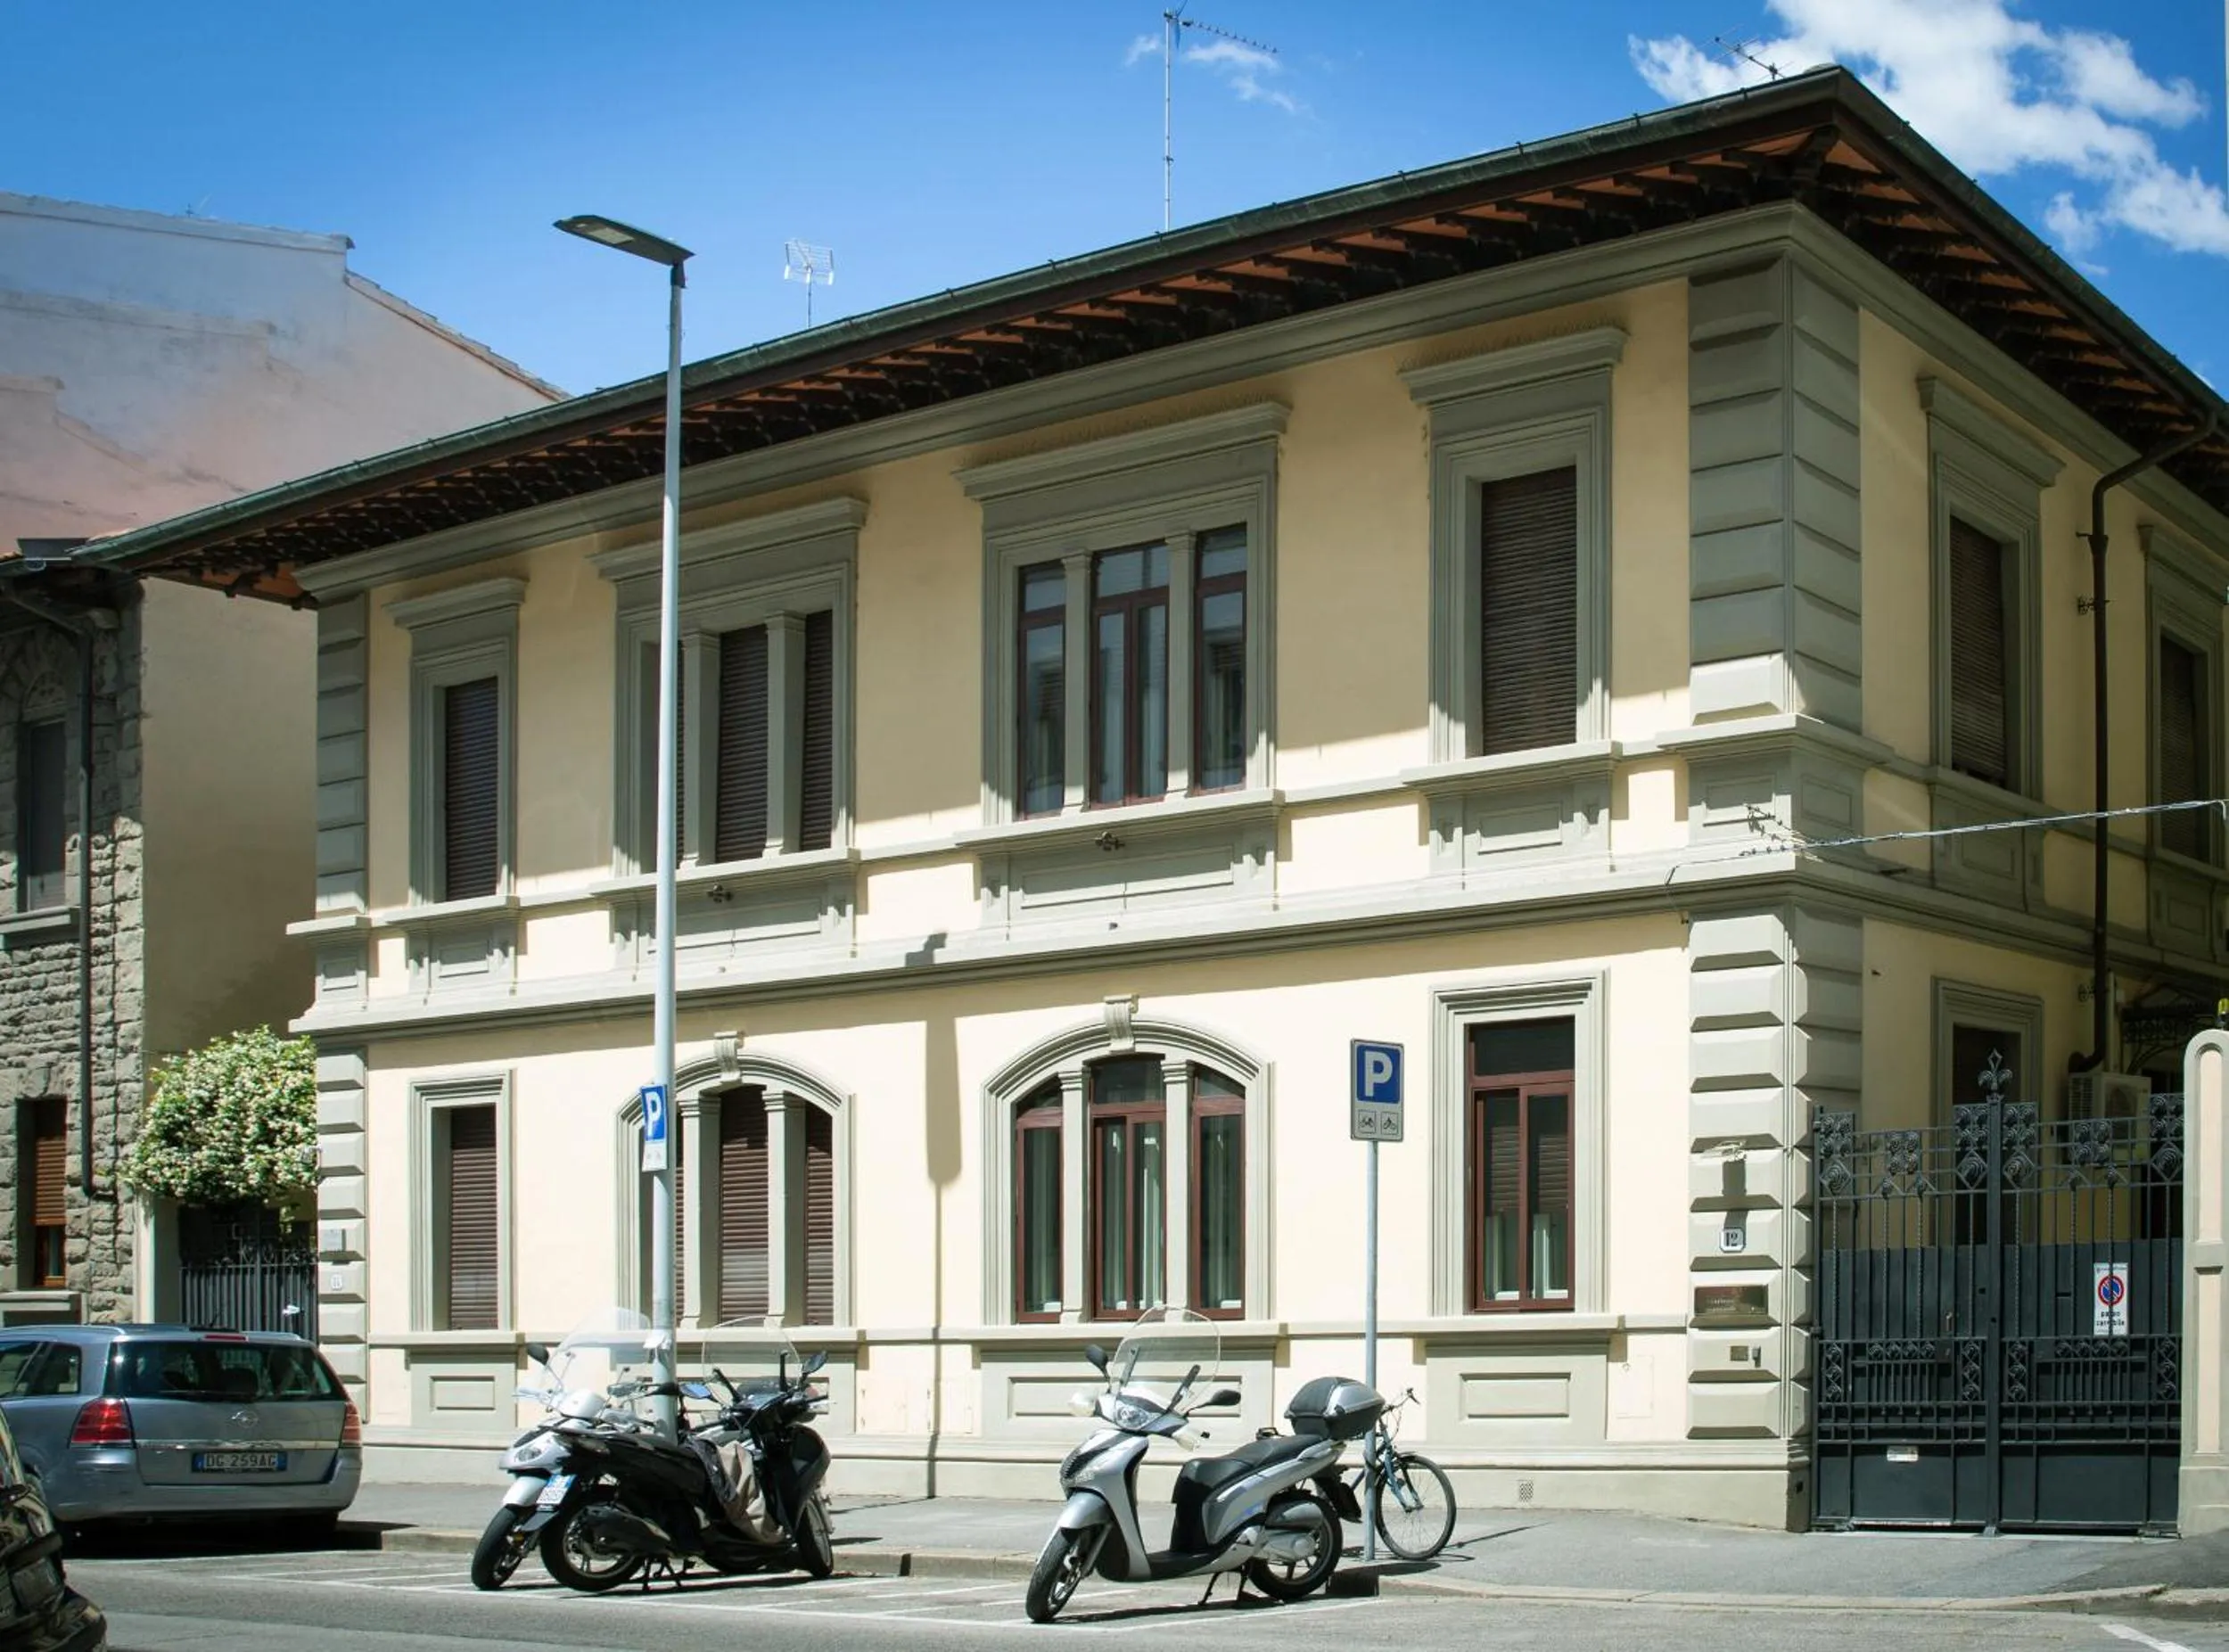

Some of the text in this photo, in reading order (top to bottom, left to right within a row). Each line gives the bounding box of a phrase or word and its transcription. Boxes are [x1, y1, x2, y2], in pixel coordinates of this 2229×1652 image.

[1364, 1050, 1393, 1097] P
[645, 1091, 662, 1138] P
[1726, 1231, 1738, 1246] 12
